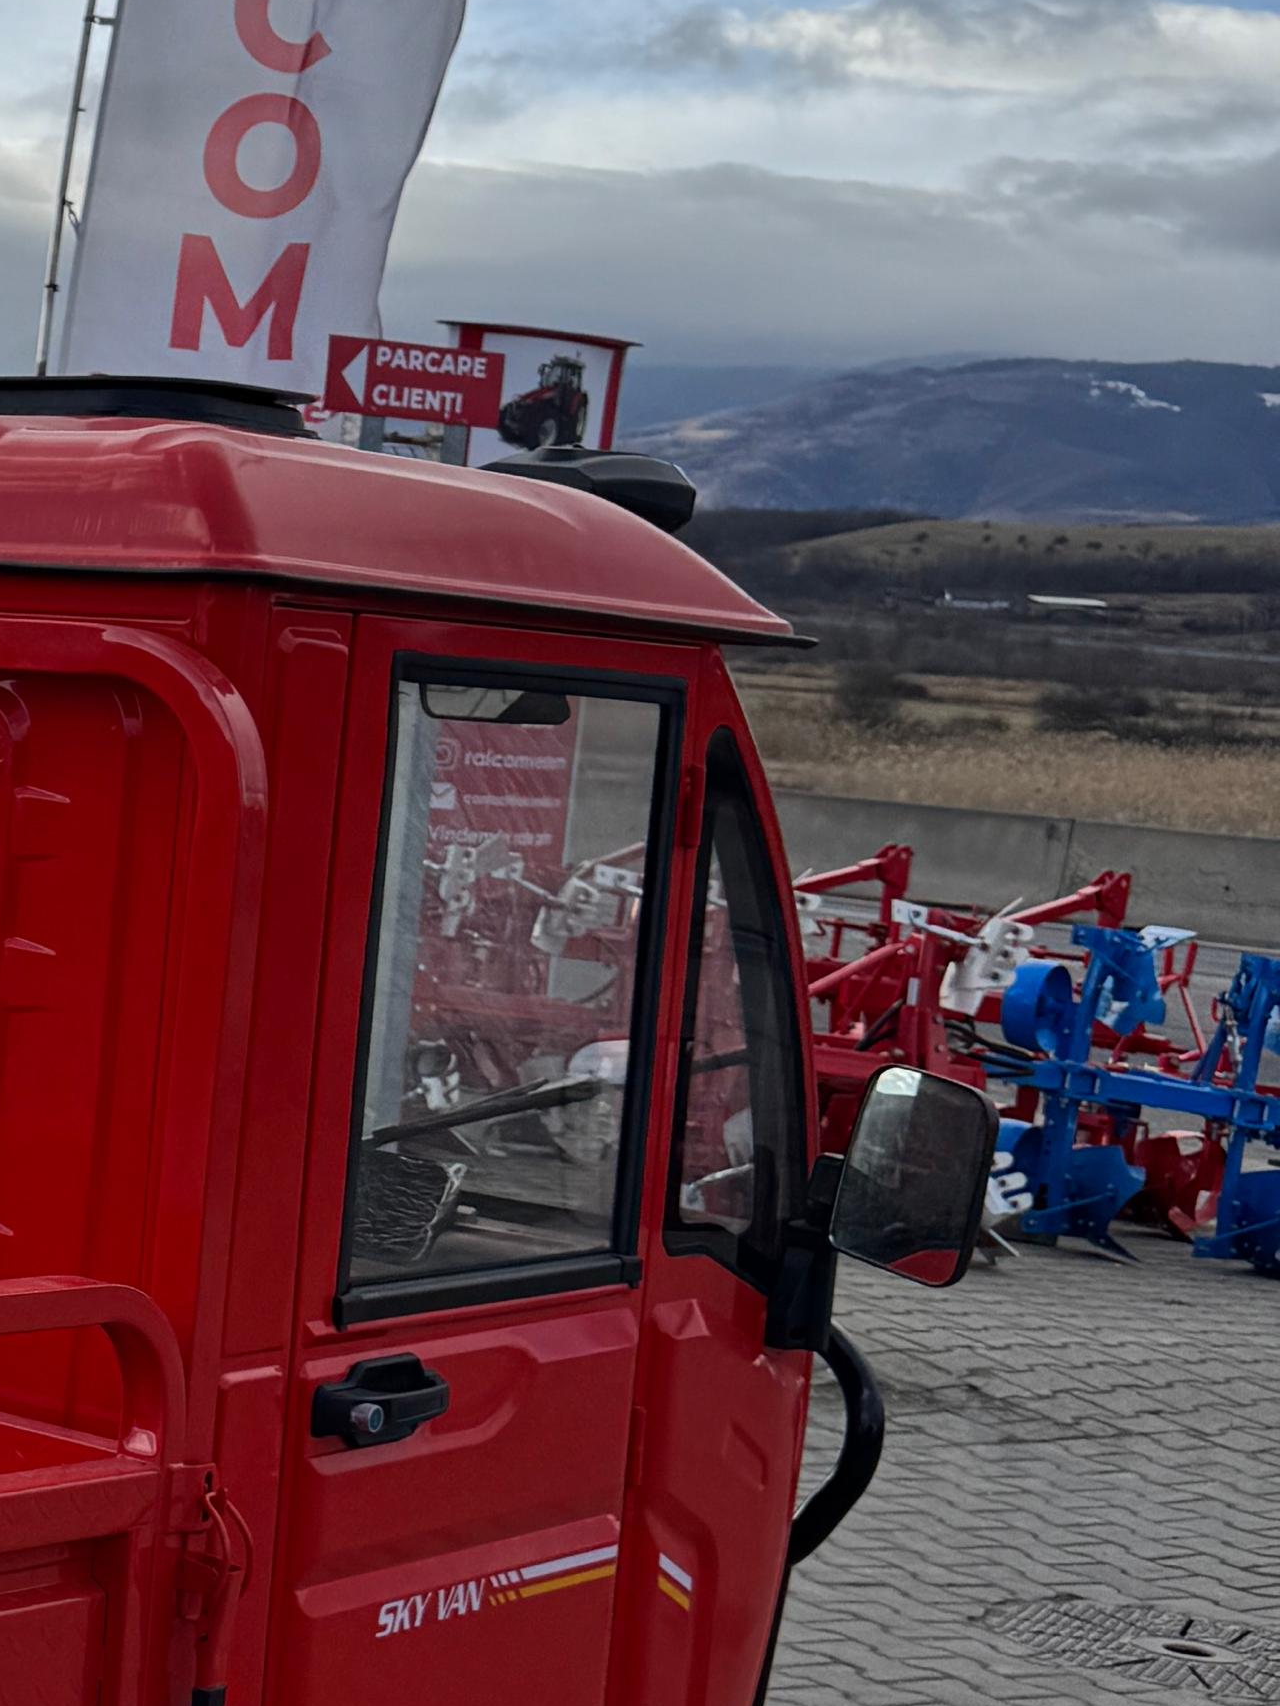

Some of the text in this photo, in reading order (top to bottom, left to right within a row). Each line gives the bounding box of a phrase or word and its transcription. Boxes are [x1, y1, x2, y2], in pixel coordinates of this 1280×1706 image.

[376, 345, 488, 379] PARCARE
[371, 383, 463, 420] CLIENȚI
[375, 1577, 486, 1638] SKY VAN
